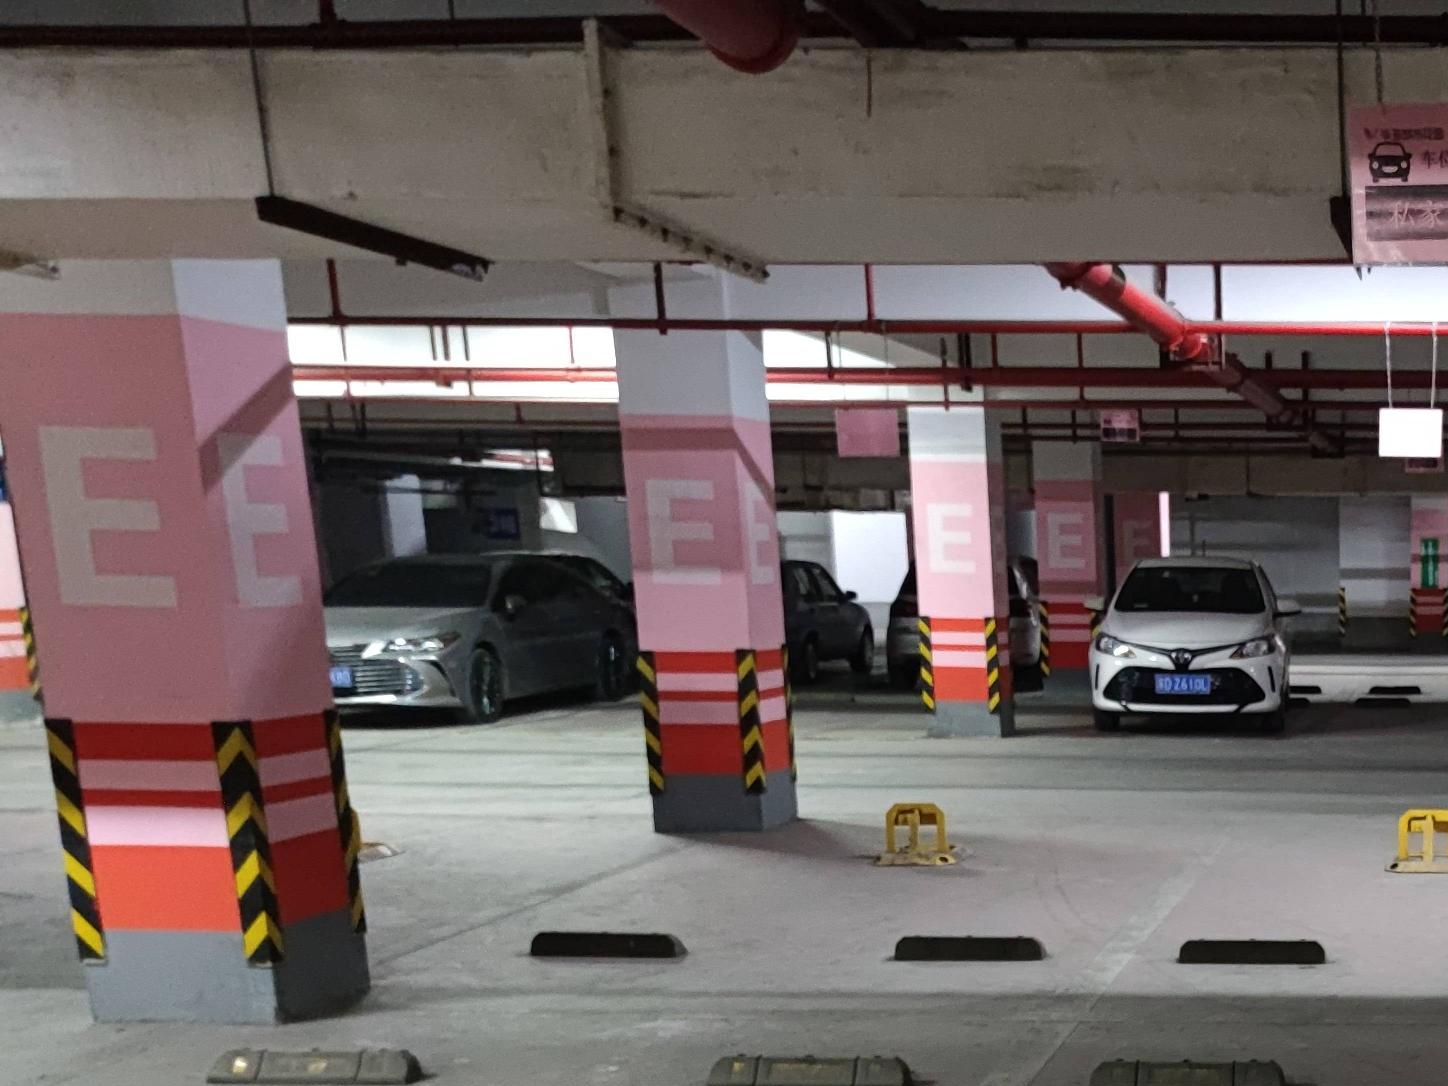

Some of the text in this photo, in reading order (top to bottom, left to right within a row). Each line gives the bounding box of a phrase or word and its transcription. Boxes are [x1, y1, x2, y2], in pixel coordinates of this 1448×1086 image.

[38, 425, 179, 608] E
[217, 432, 300, 608] E
[645, 478, 722, 585] E
[742, 479, 775, 585] E
[926, 502, 976, 574] E
[1048, 512, 1087, 568] E
